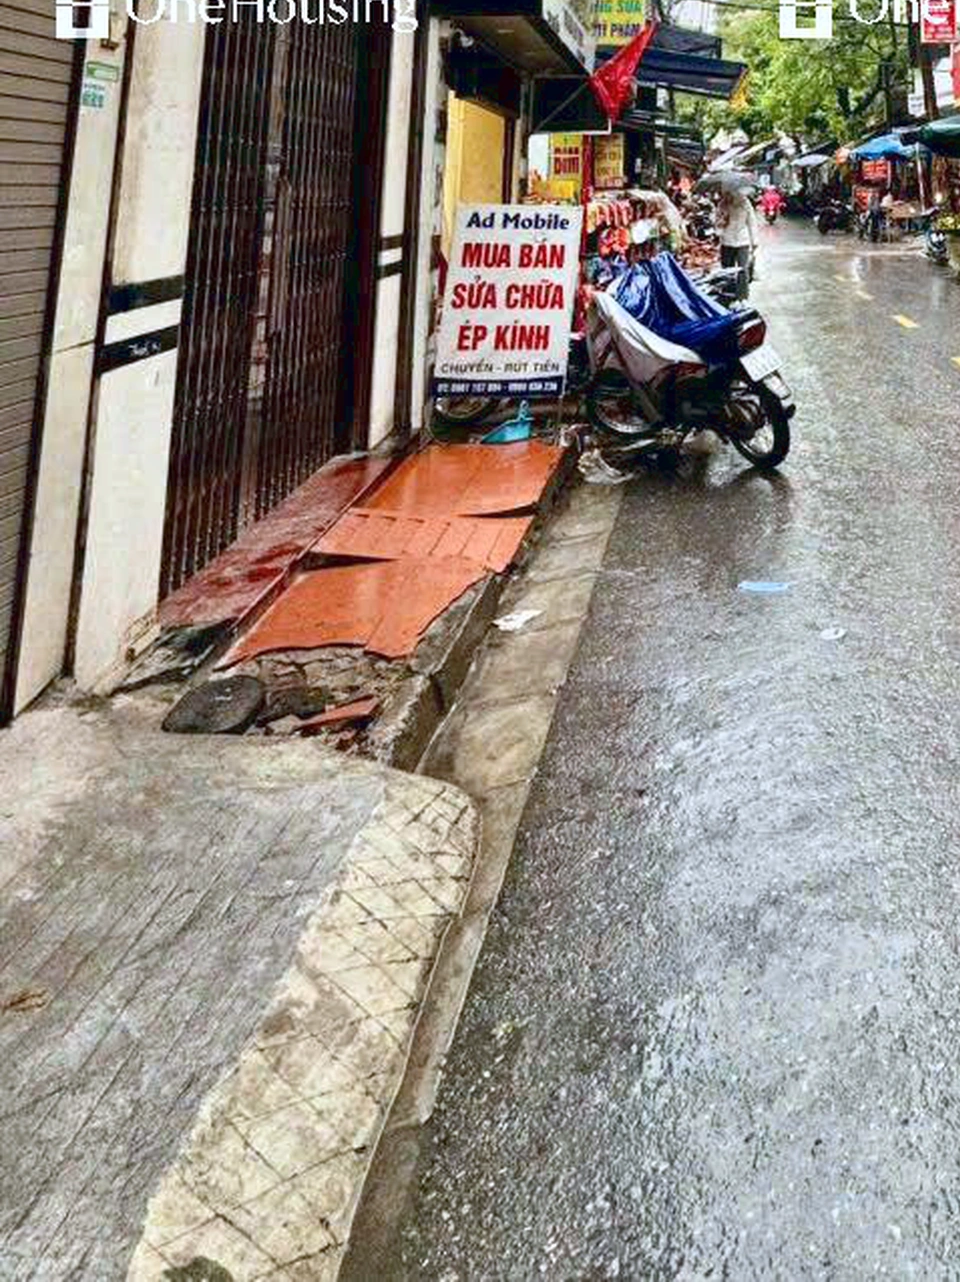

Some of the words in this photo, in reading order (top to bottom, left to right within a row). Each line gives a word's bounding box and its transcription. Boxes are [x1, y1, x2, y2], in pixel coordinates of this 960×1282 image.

[466, 213, 495, 229] Ad
[502, 213, 570, 230] Mobile
[461, 242, 511, 268] MUA
[518, 238, 566, 269] BÁN
[451, 275, 498, 309] SỬA
[505, 279, 565, 310] CHỮA
[457, 319, 488, 351] ÉP
[494, 319, 551, 351] KÍNH
